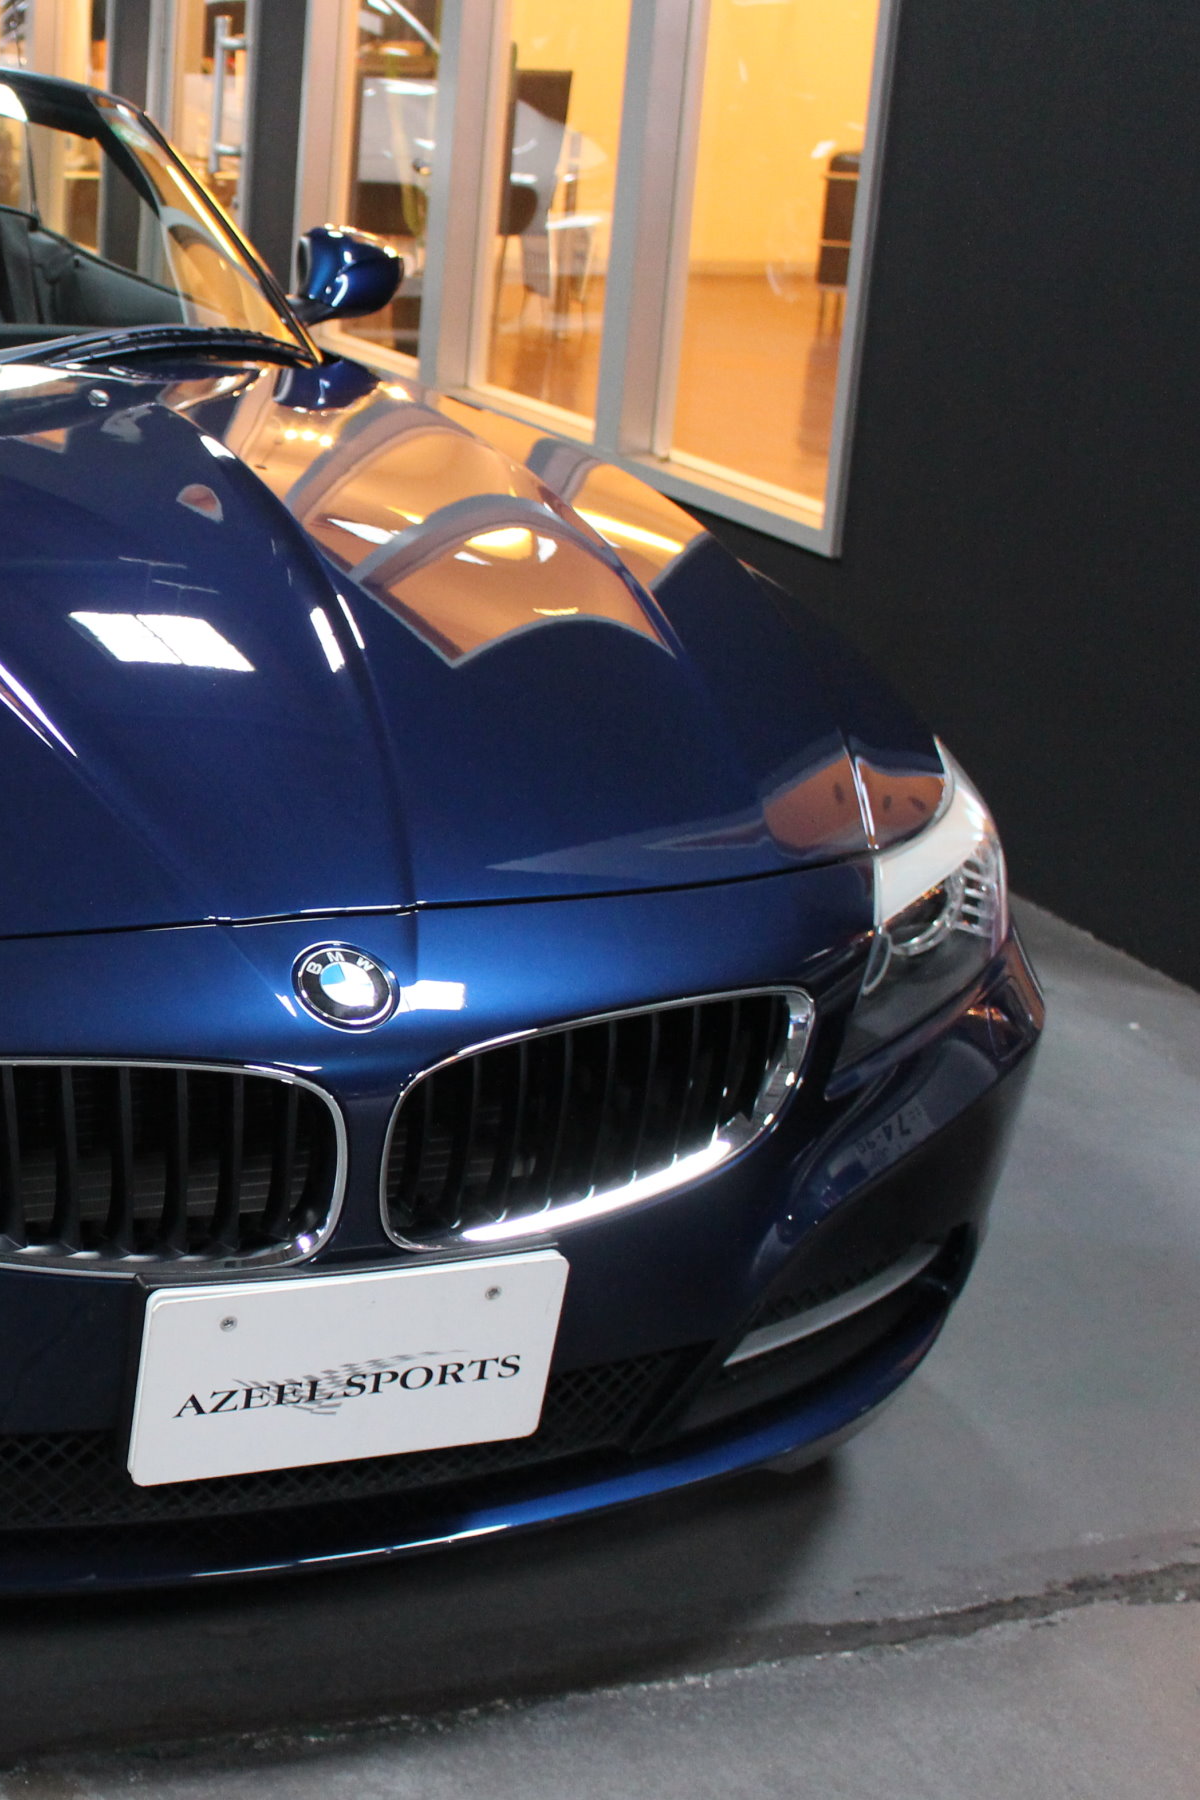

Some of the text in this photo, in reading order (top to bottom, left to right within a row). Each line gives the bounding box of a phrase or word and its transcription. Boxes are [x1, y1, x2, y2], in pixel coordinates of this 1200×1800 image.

[305, 951, 375, 975] BMW
[172, 1354, 521, 1418] AZEEL SPORTS
